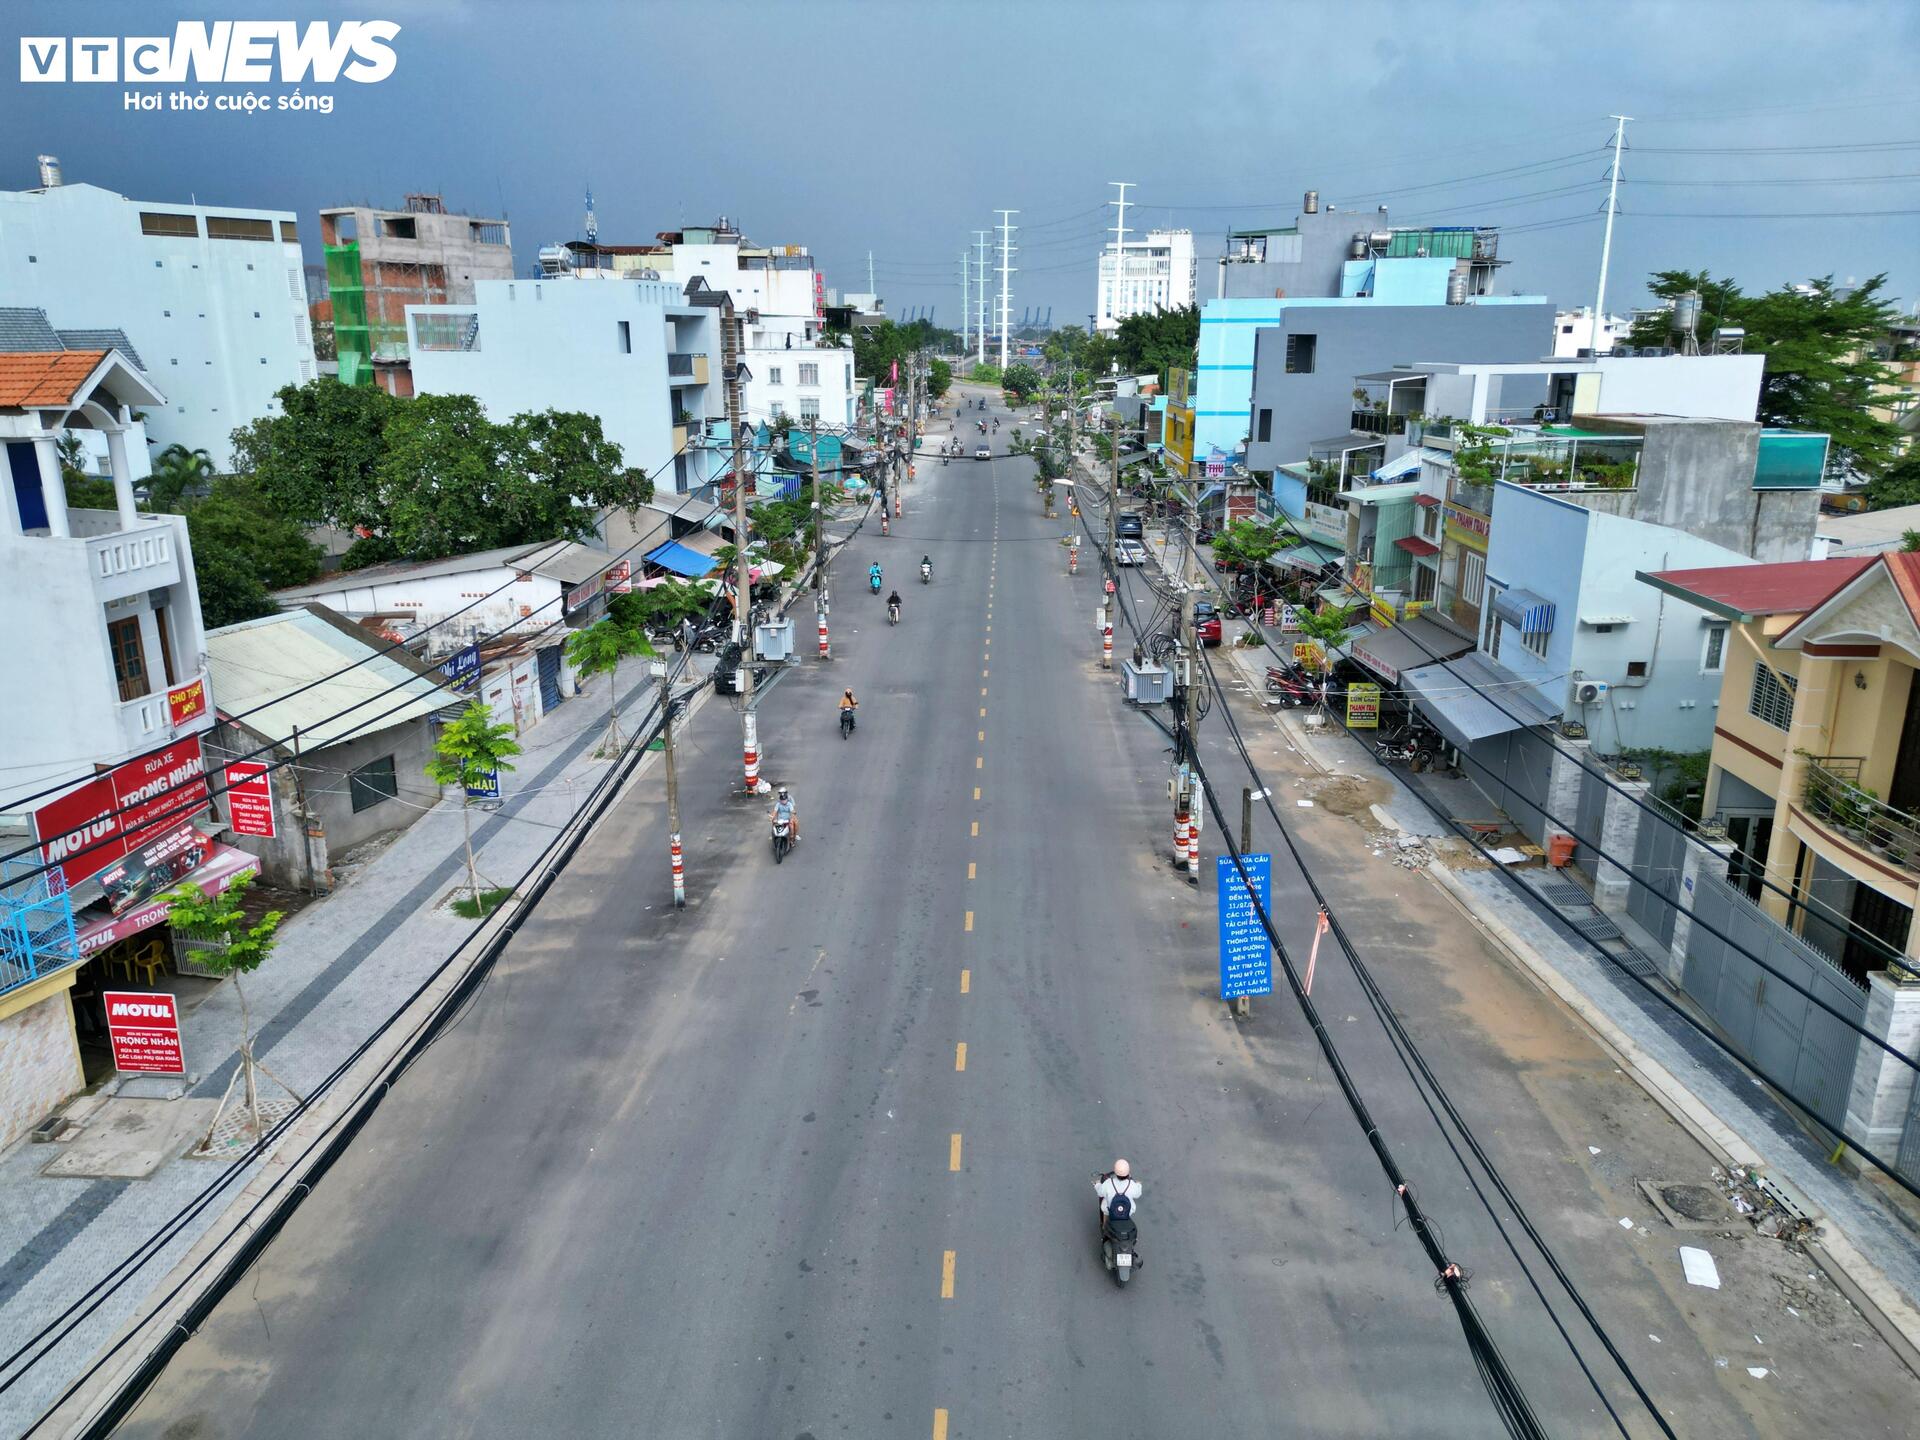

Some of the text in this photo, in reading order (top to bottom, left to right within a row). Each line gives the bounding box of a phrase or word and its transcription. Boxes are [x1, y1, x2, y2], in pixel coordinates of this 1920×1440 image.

[163, 752, 175, 766] XE
[112, 1003, 172, 1018] MOTUL
[114, 1036, 178, 1047] TRỌNG NHÂN
